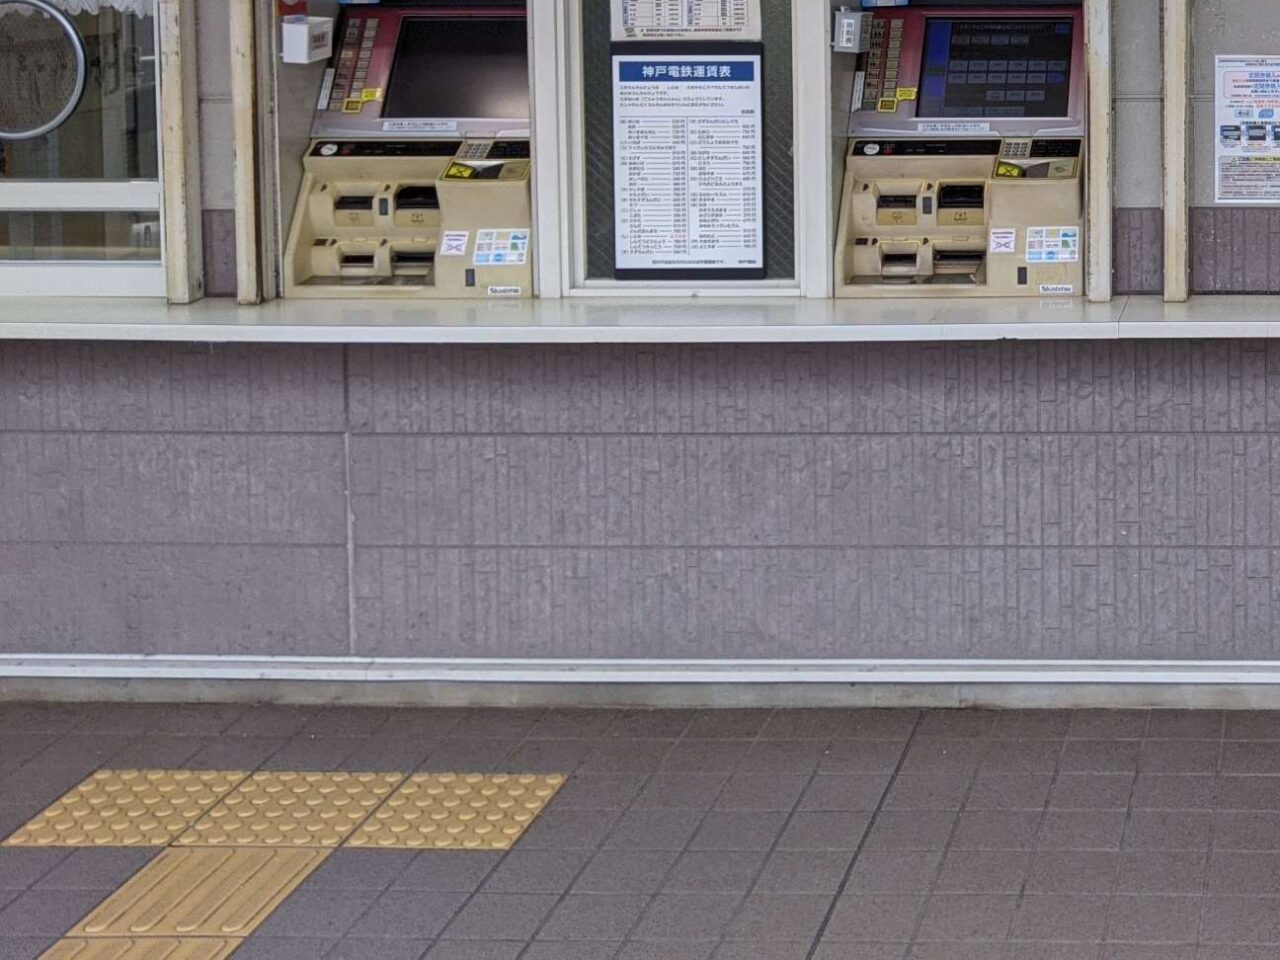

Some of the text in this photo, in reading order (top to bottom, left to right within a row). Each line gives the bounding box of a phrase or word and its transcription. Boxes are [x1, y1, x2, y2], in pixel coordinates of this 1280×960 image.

[642, 65, 731, 78] 神戸電鉄運賃表
